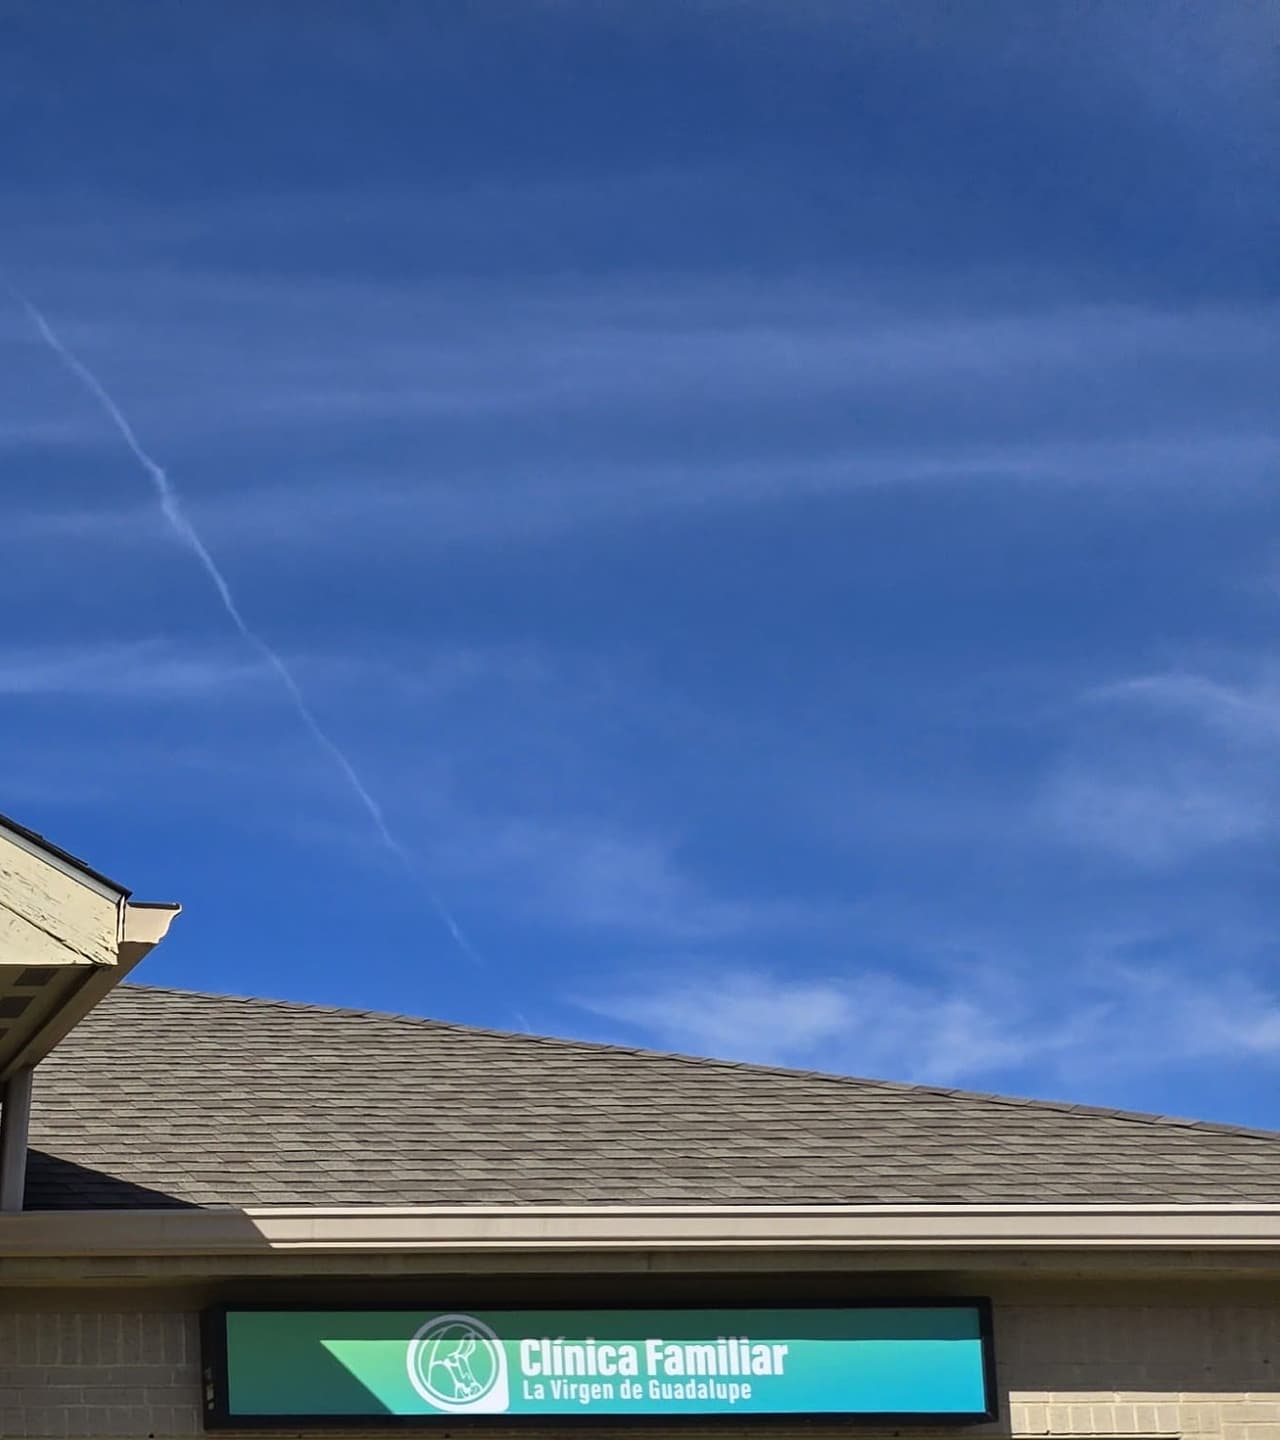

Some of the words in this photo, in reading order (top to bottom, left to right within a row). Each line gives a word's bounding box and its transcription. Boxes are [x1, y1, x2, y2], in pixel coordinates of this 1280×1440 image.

[520, 1336, 638, 1376] Clínica
[645, 1336, 788, 1376] Familiar
[523, 1379, 544, 1400] La
[551, 1379, 614, 1404] Virgen
[620, 1379, 643, 1400] de
[649, 1379, 752, 1404] Guadalupe
